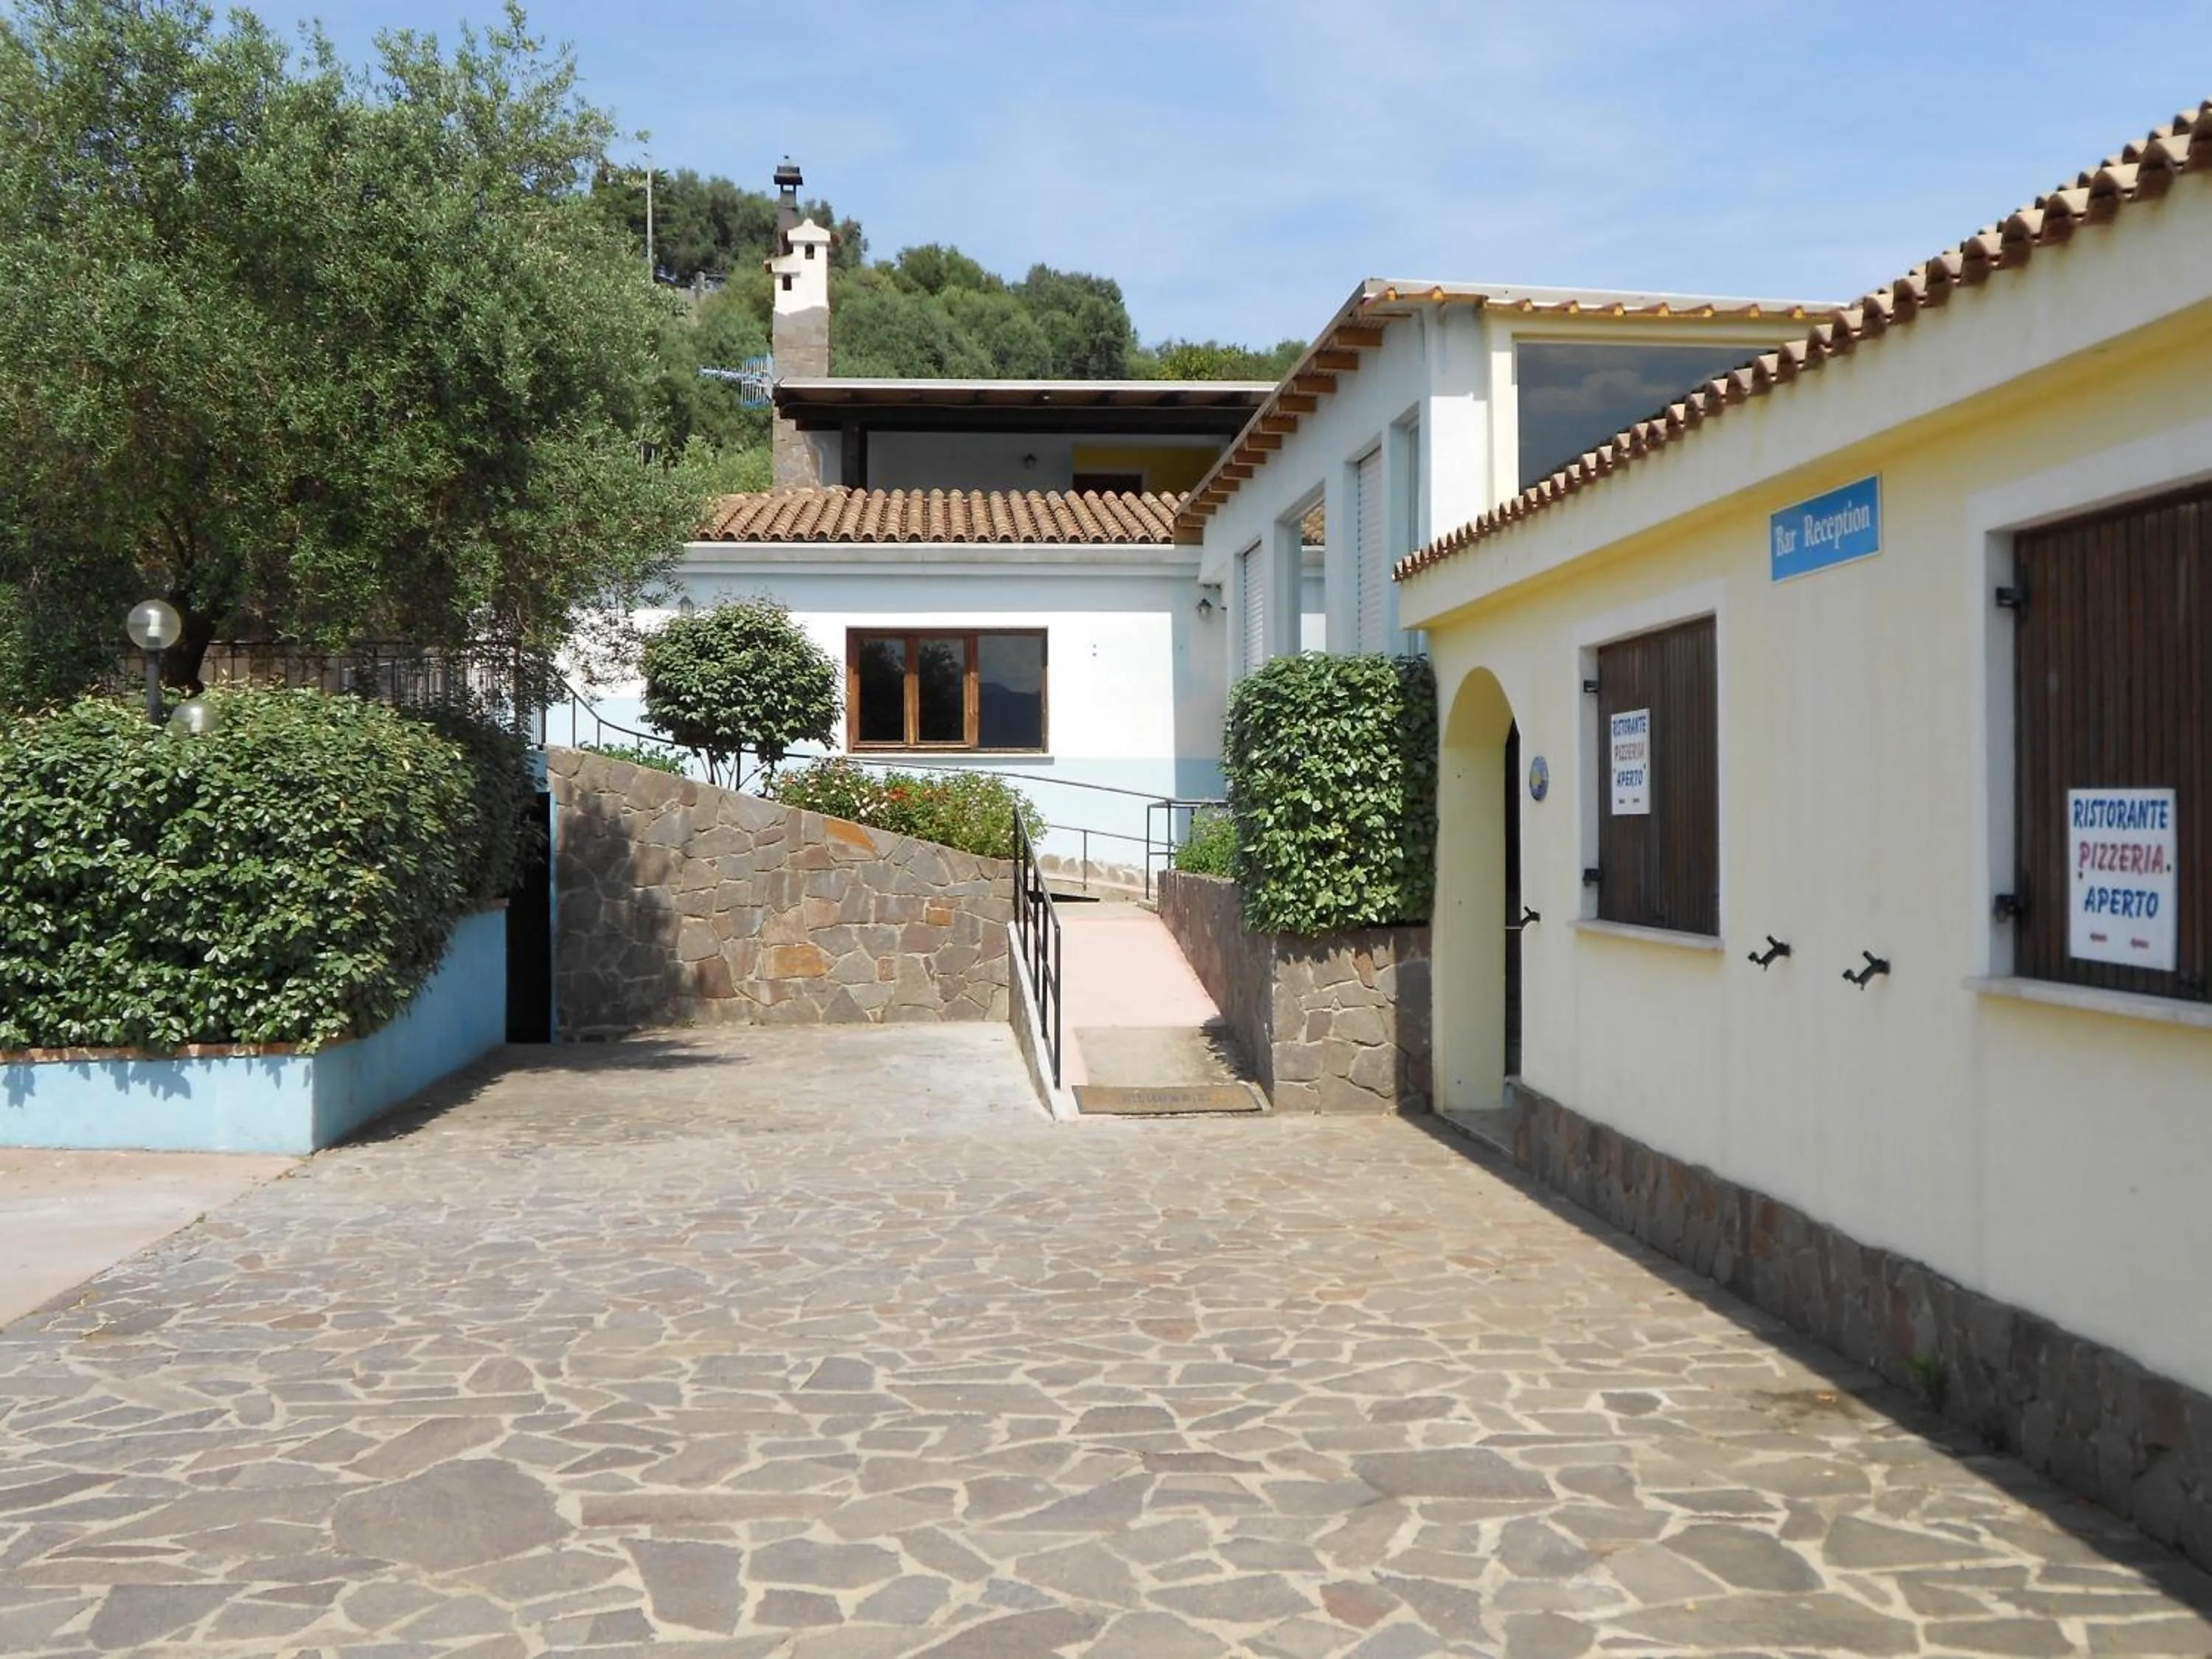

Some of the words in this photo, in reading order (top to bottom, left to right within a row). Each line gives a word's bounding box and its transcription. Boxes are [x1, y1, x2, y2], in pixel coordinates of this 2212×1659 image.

[1775, 524, 1795, 557] Bar
[1804, 499, 1871, 550] Reception
[1616, 769, 1644, 787] APERTO
[2073, 799, 2169, 830] RISTORANTE
[2079, 841, 2165, 876] PIZZERIA
[2084, 885, 2160, 919] APERTO
